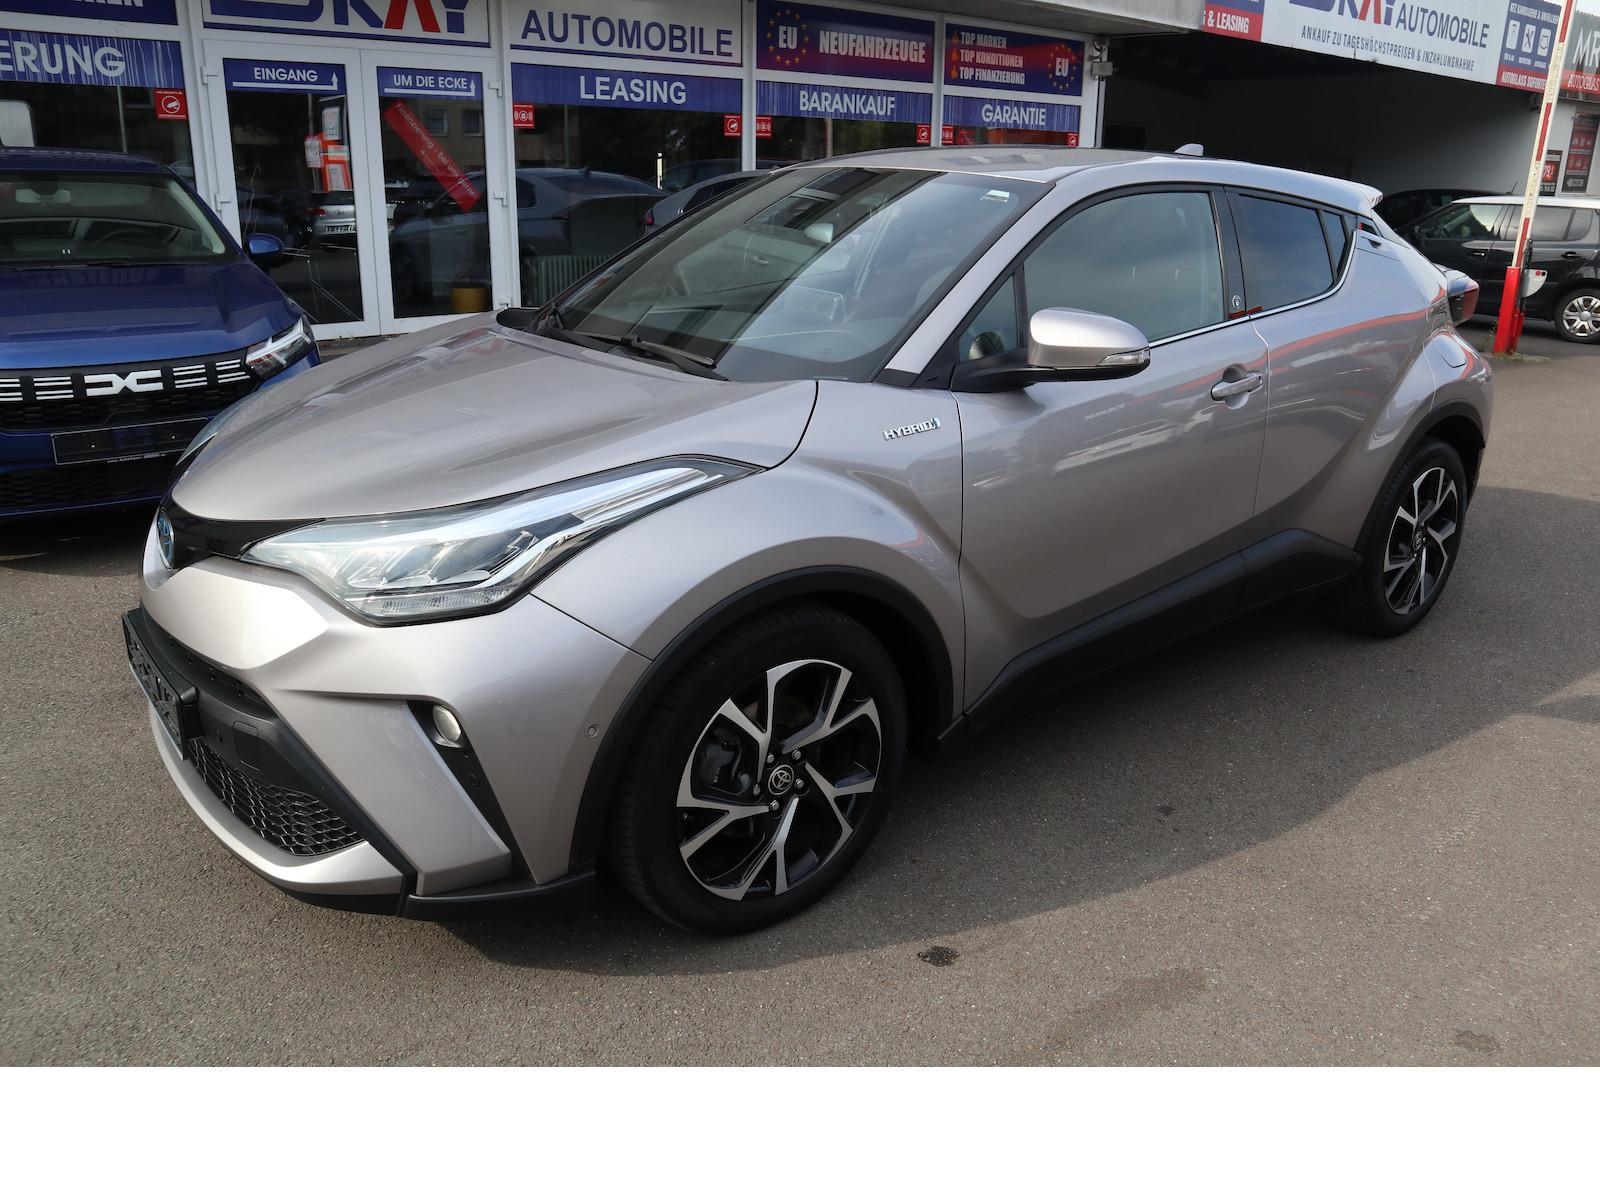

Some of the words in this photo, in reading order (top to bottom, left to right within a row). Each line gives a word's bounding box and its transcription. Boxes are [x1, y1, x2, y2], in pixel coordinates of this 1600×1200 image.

[521, 9, 733, 57] AUTOMOBILE
[1207, 10, 1215, 27] &
[1216, 12, 1250, 34] LEASING
[1396, 4, 1490, 48] AUTOMOBILE
[778, 25, 798, 50] EU
[819, 30, 926, 64] NEUFAHRZEUGE
[960, 32, 976, 45] TOP
[977, 34, 1007, 49] MARKEN
[1301, 25, 1331, 42] ANKAUF
[1331, 31, 1342, 46] ZU
[1342, 33, 1416, 61] TAGESHÖCHSTPREISEN
[960, 49, 975, 63] TOP
[976, 51, 1024, 68] KONDITIONEN
[1055, 57, 1070, 77] EU
[253, 67, 318, 82] EINGANG
[393, 74, 413, 87] UM
[416, 75, 435, 88] DIE
[438, 76, 468, 89] ECKE
[959, 66, 974, 80] TOP
[975, 68, 1025, 85] FINANZIERUNG
[579, 75, 687, 105] LEASING
[799, 90, 896, 116] BARANKAUF
[981, 104, 1047, 126] GARANTIE
[882, 420, 934, 441] HYBRID
